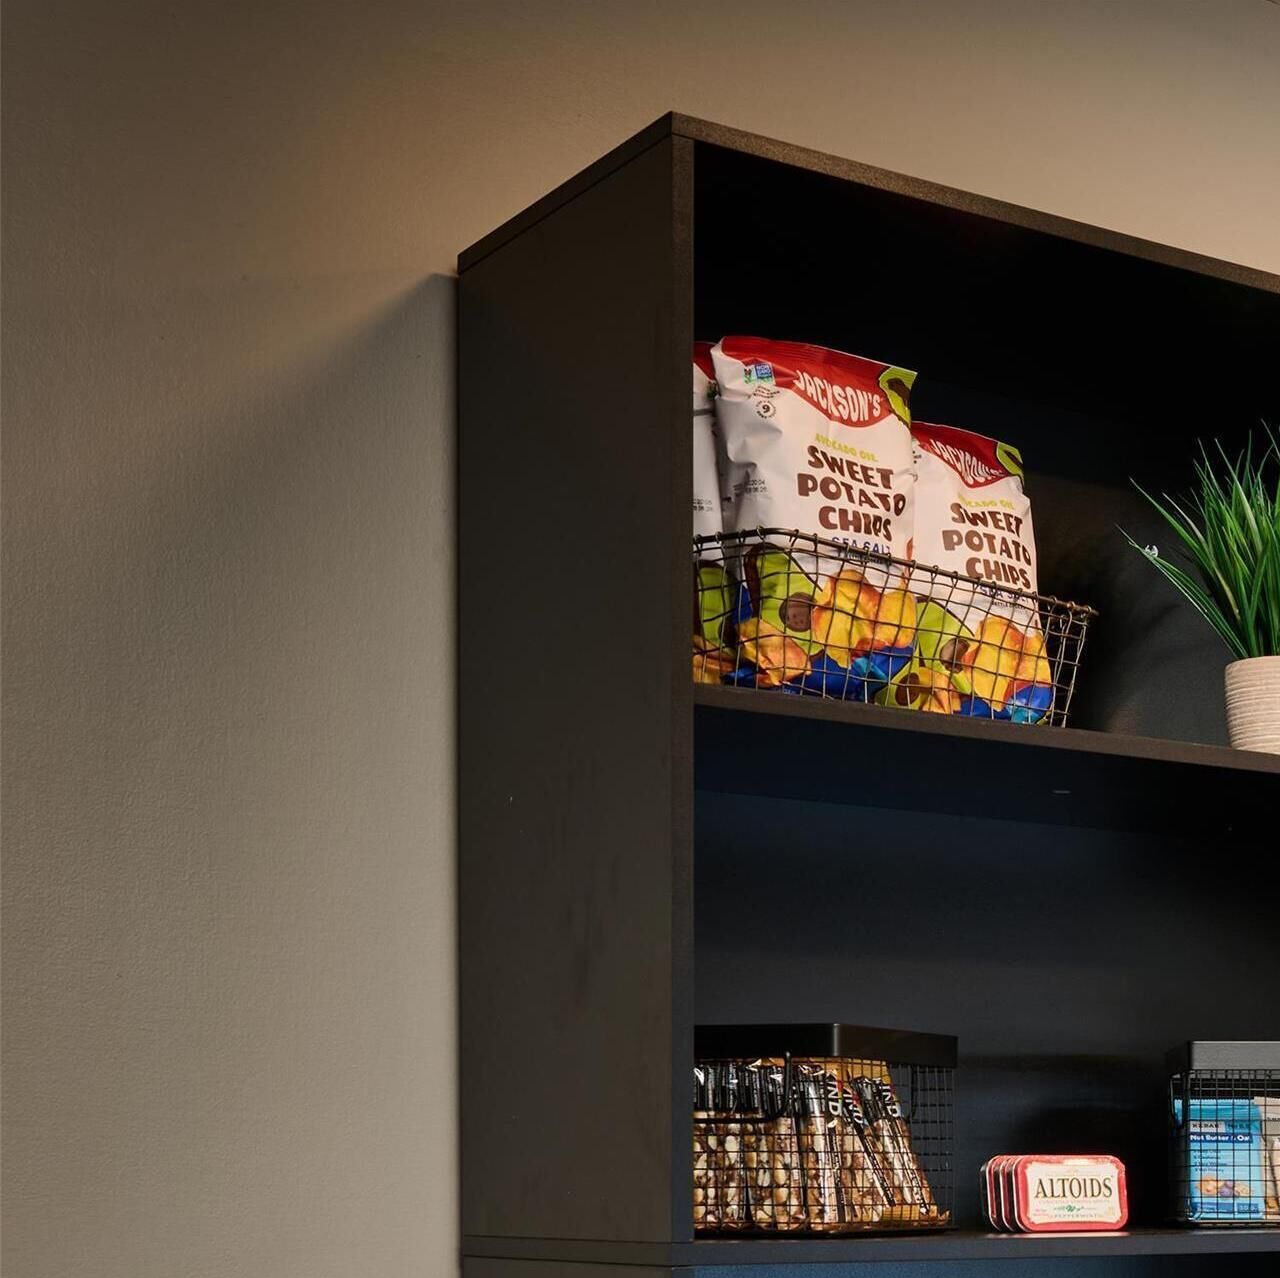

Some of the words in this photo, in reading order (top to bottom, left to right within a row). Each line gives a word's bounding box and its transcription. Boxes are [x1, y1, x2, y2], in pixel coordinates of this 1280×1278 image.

[793, 370, 881, 422] JACKSON'S
[807, 445, 894, 490] SWEET
[797, 472, 906, 516] POTATO
[818, 505, 892, 542] CHIPS
[950, 502, 1023, 538] SWEET
[942, 529, 1032, 567] POTATO
[965, 556, 1032, 590] CHIPS
[1035, 1177, 1113, 1199] ALTOIDS
